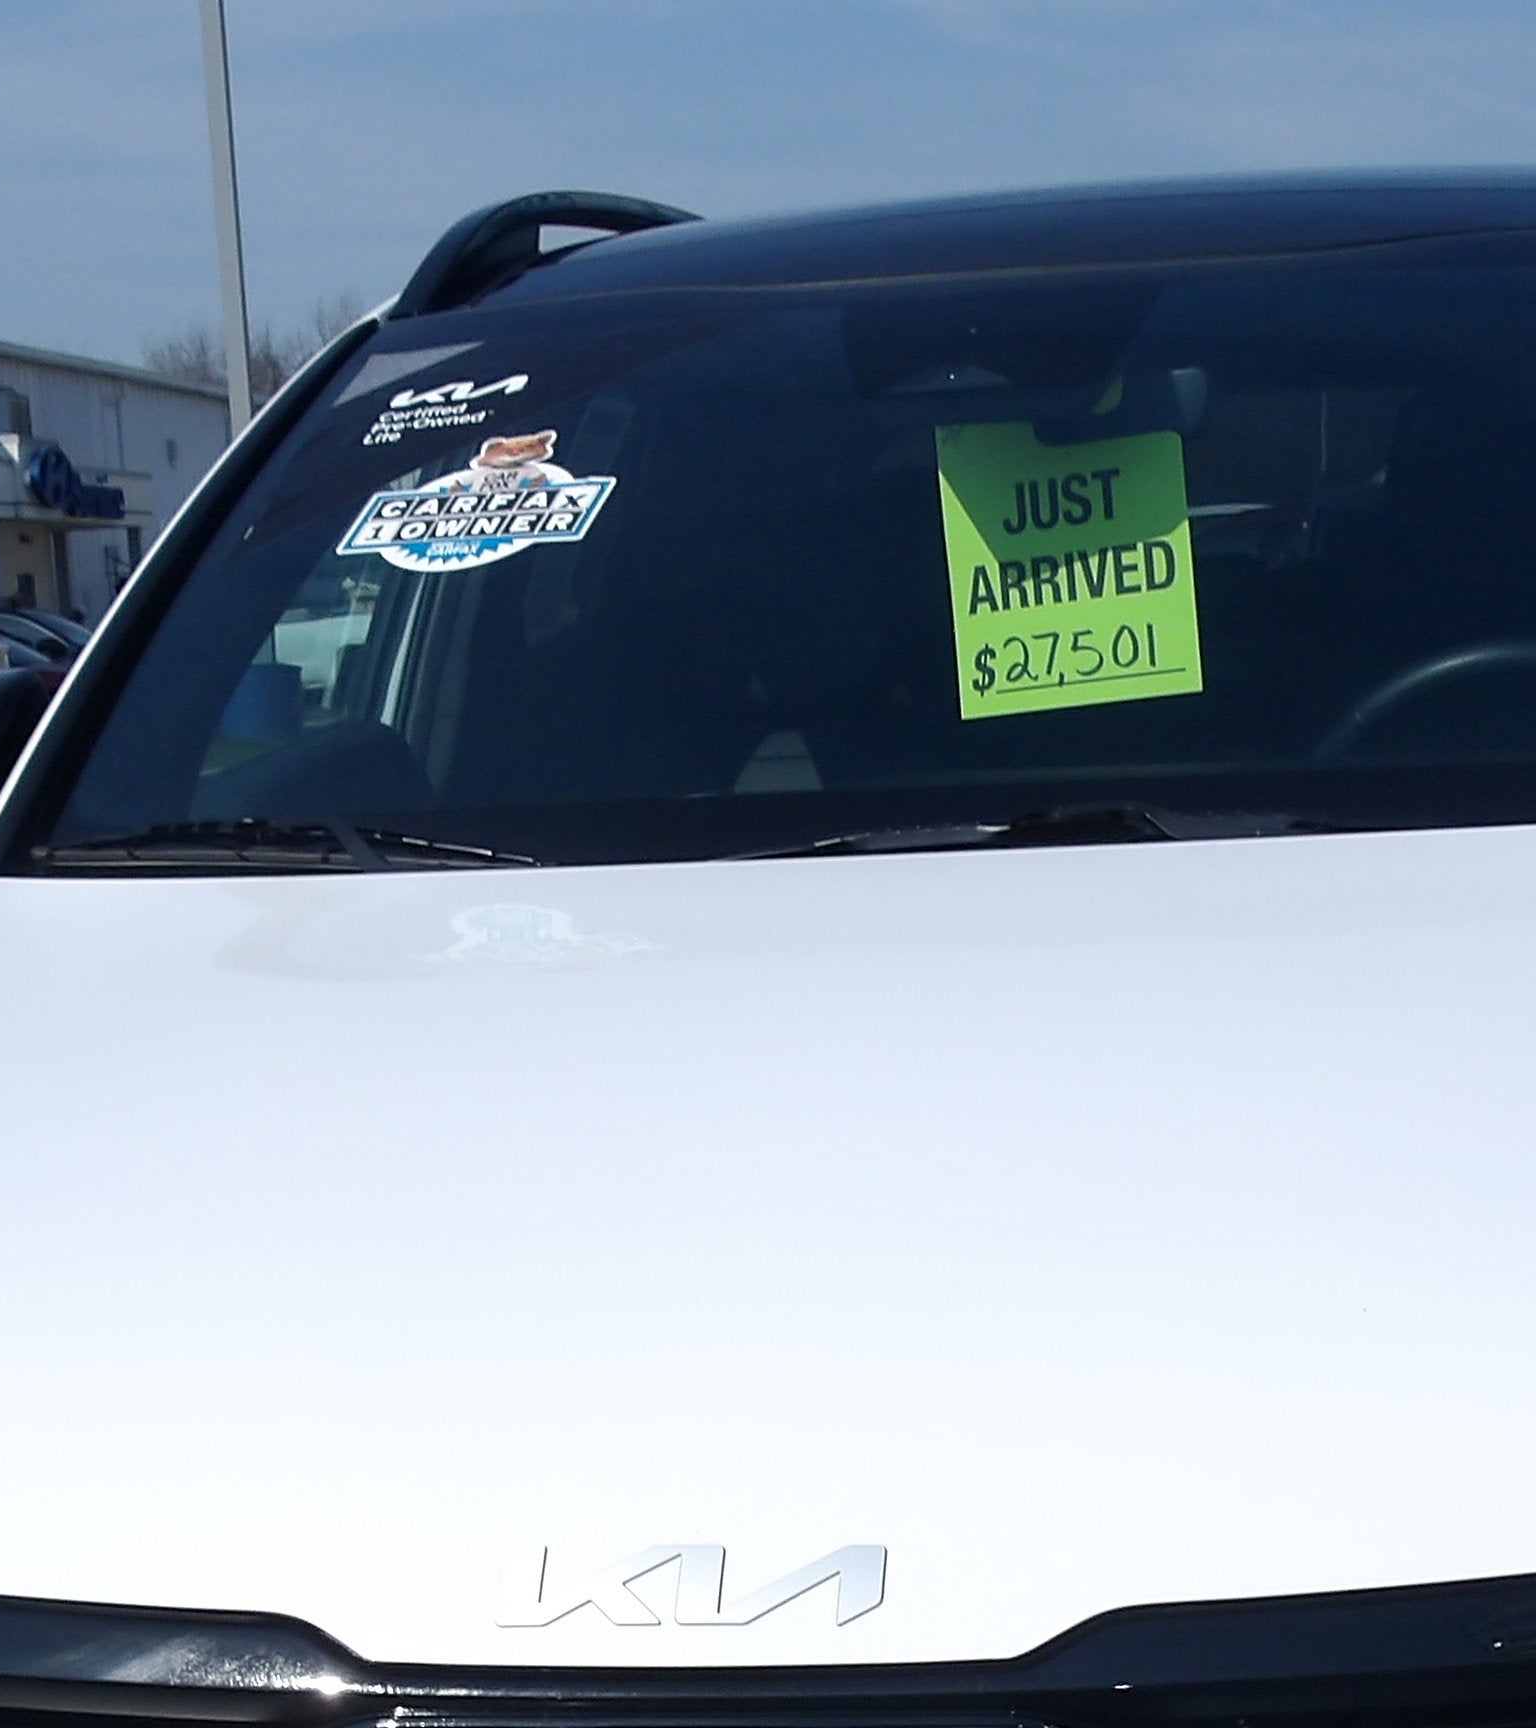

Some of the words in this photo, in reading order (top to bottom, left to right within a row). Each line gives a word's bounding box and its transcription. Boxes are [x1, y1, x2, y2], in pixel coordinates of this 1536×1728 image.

[390, 374, 529, 408] KIA
[370, 410, 487, 433] Pre-Owned
[379, 403, 468, 423] Certified
[380, 491, 586, 518] CARFAX
[1002, 468, 1120, 535] JUST
[366, 524, 387, 541] 1
[400, 512, 575, 540] OWNER
[968, 539, 1176, 616] ARRIVED
[971, 623, 1157, 698] $27,501
[495, 1544, 888, 1627] KIA
